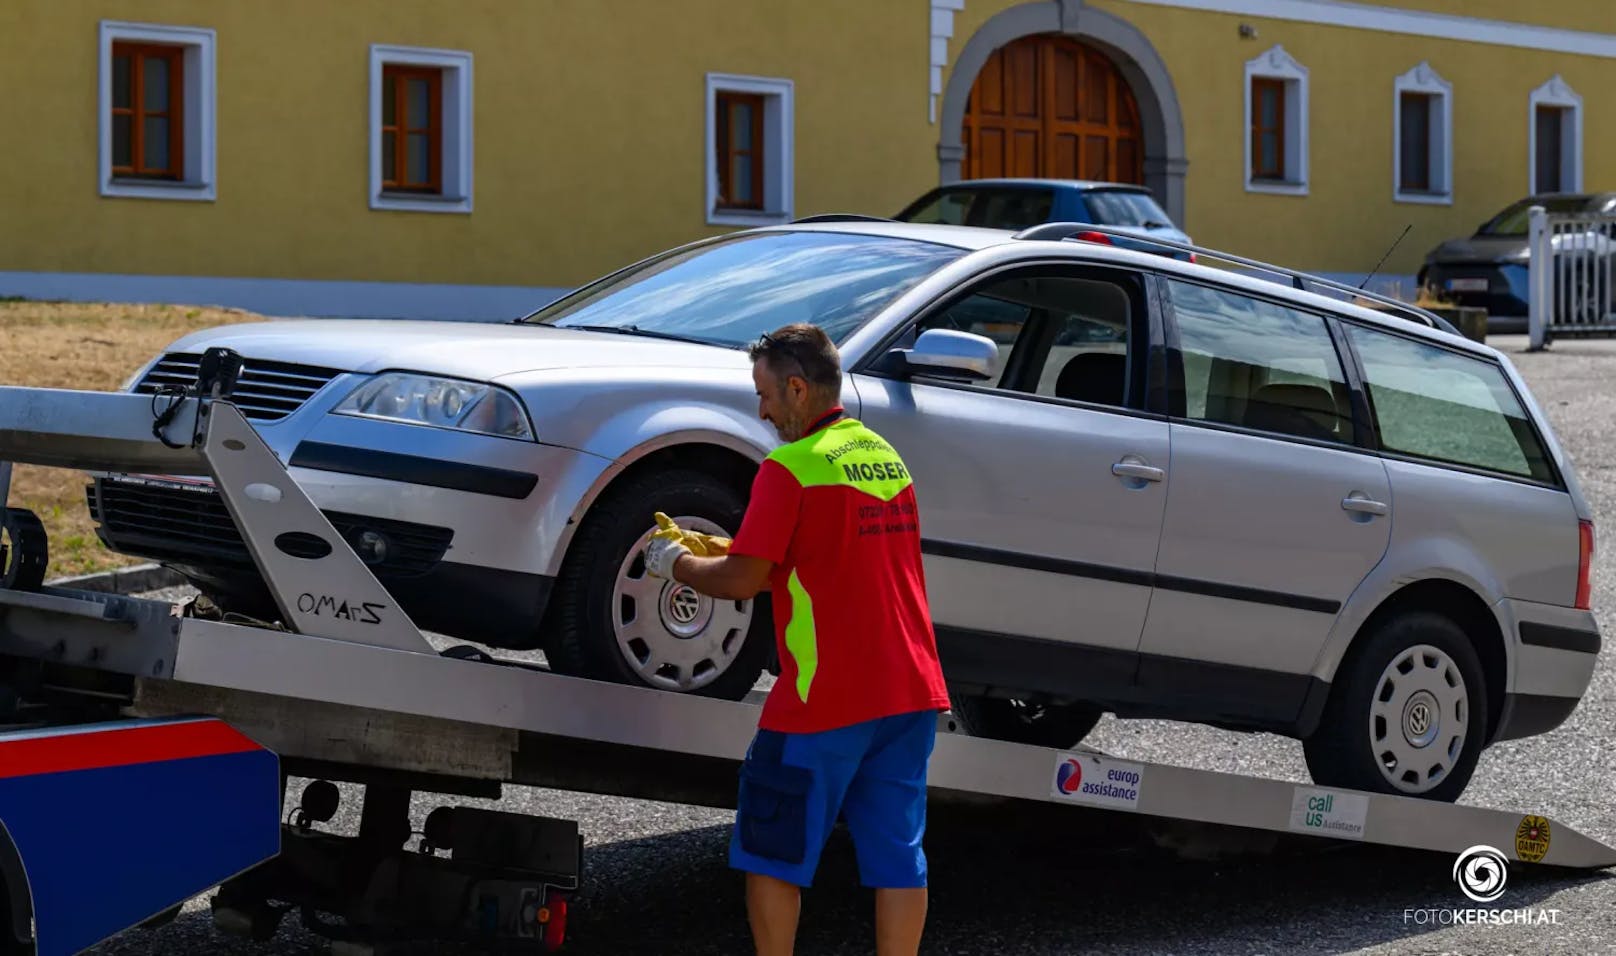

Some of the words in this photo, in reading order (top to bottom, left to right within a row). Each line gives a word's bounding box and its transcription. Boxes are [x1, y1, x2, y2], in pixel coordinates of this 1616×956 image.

[843, 462, 909, 481] MOSER
[1107, 769, 1140, 786] europ
[1082, 781, 1136, 800] assistance
[1308, 794, 1333, 812] call
[1305, 812, 1323, 827] us
